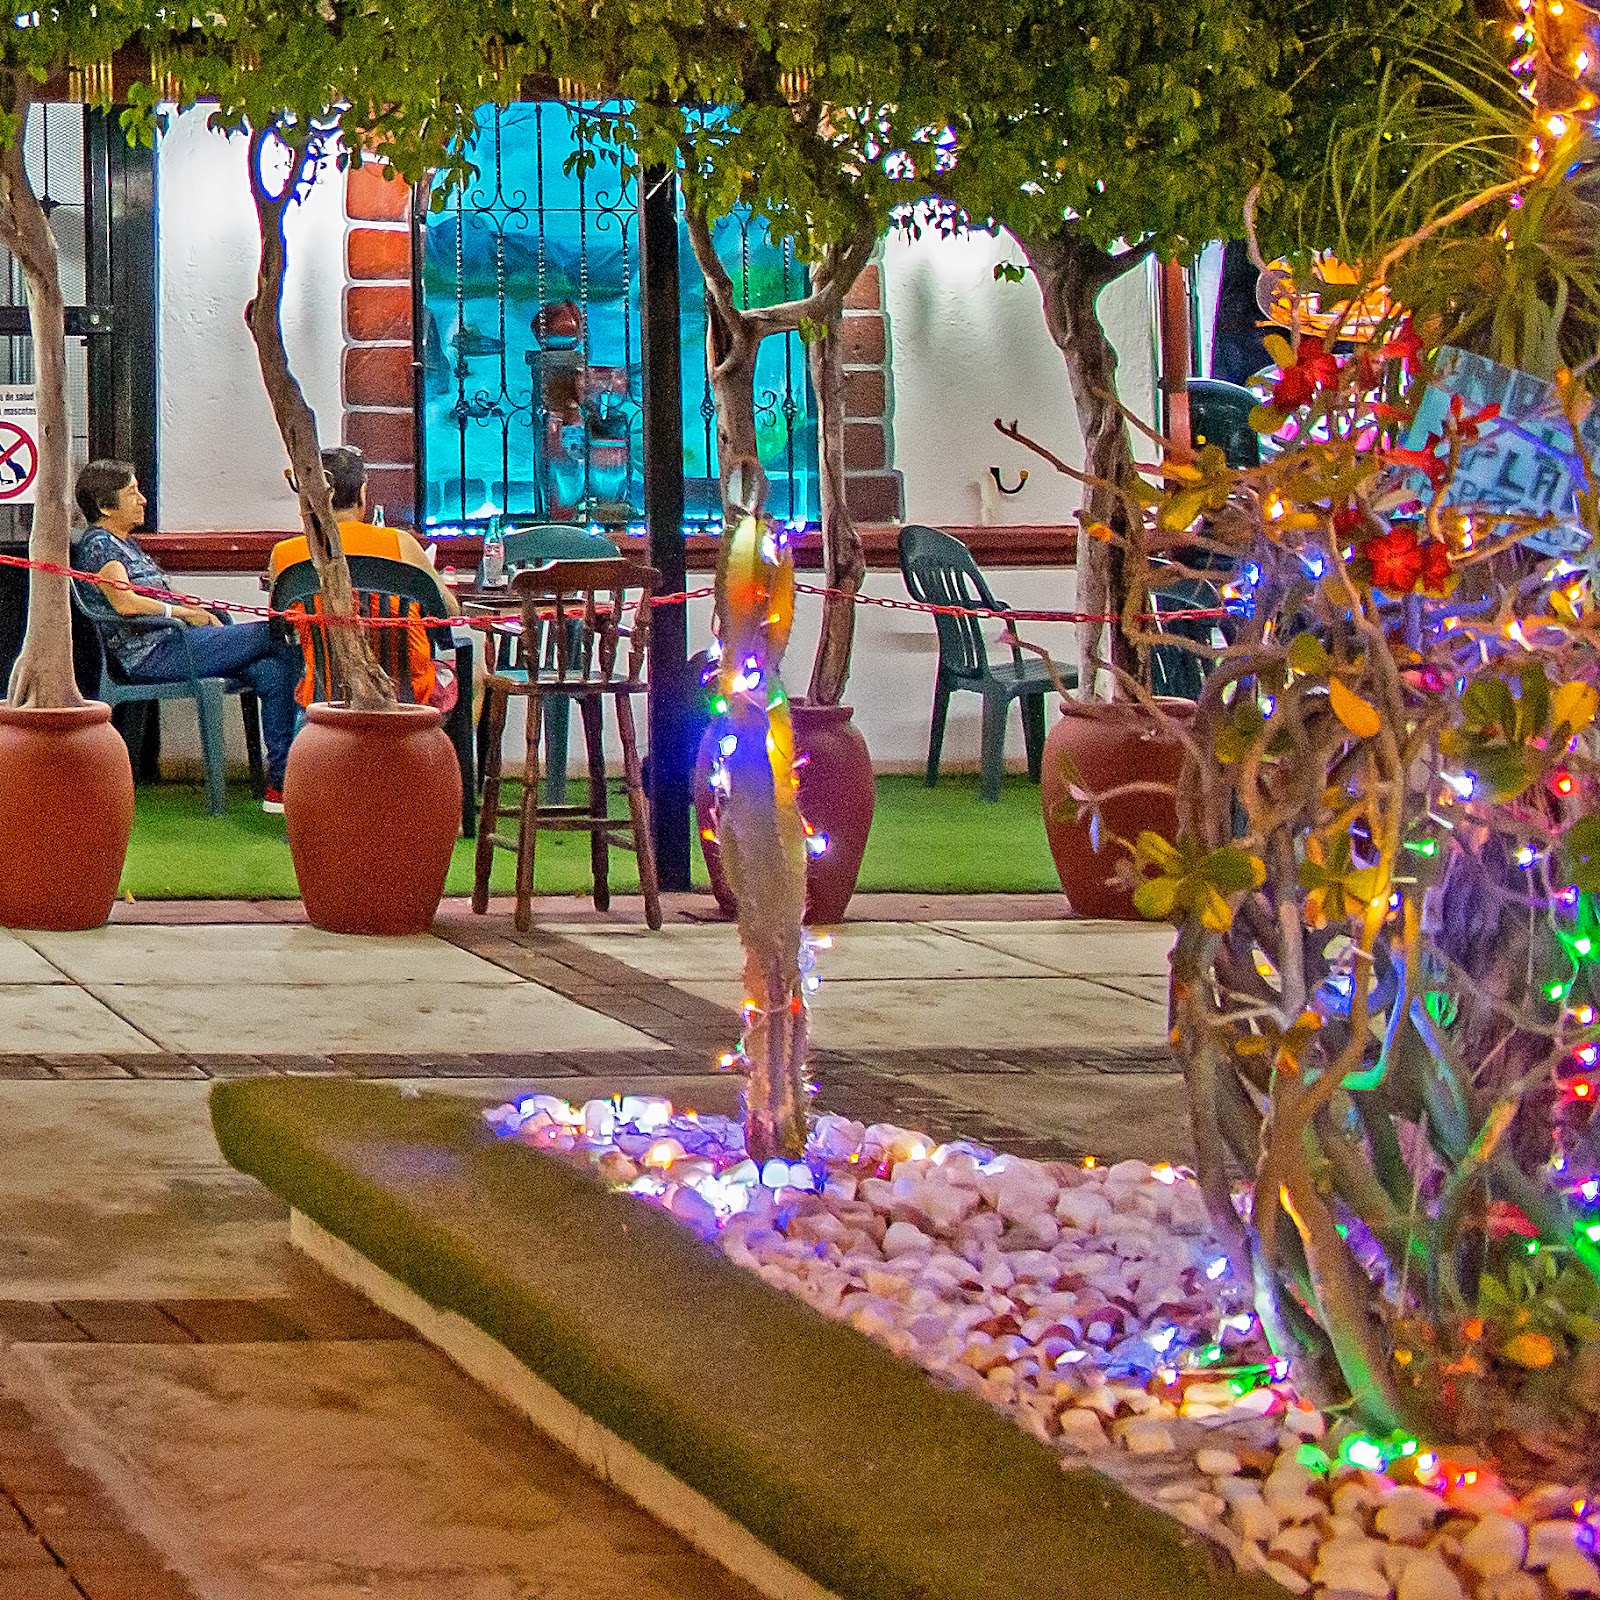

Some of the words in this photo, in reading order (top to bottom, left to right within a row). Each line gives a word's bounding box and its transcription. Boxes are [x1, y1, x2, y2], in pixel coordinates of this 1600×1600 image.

[5, 392, 14, 401] de
[15, 392, 34, 401] salud
[3, 407, 36, 416] mascotas
